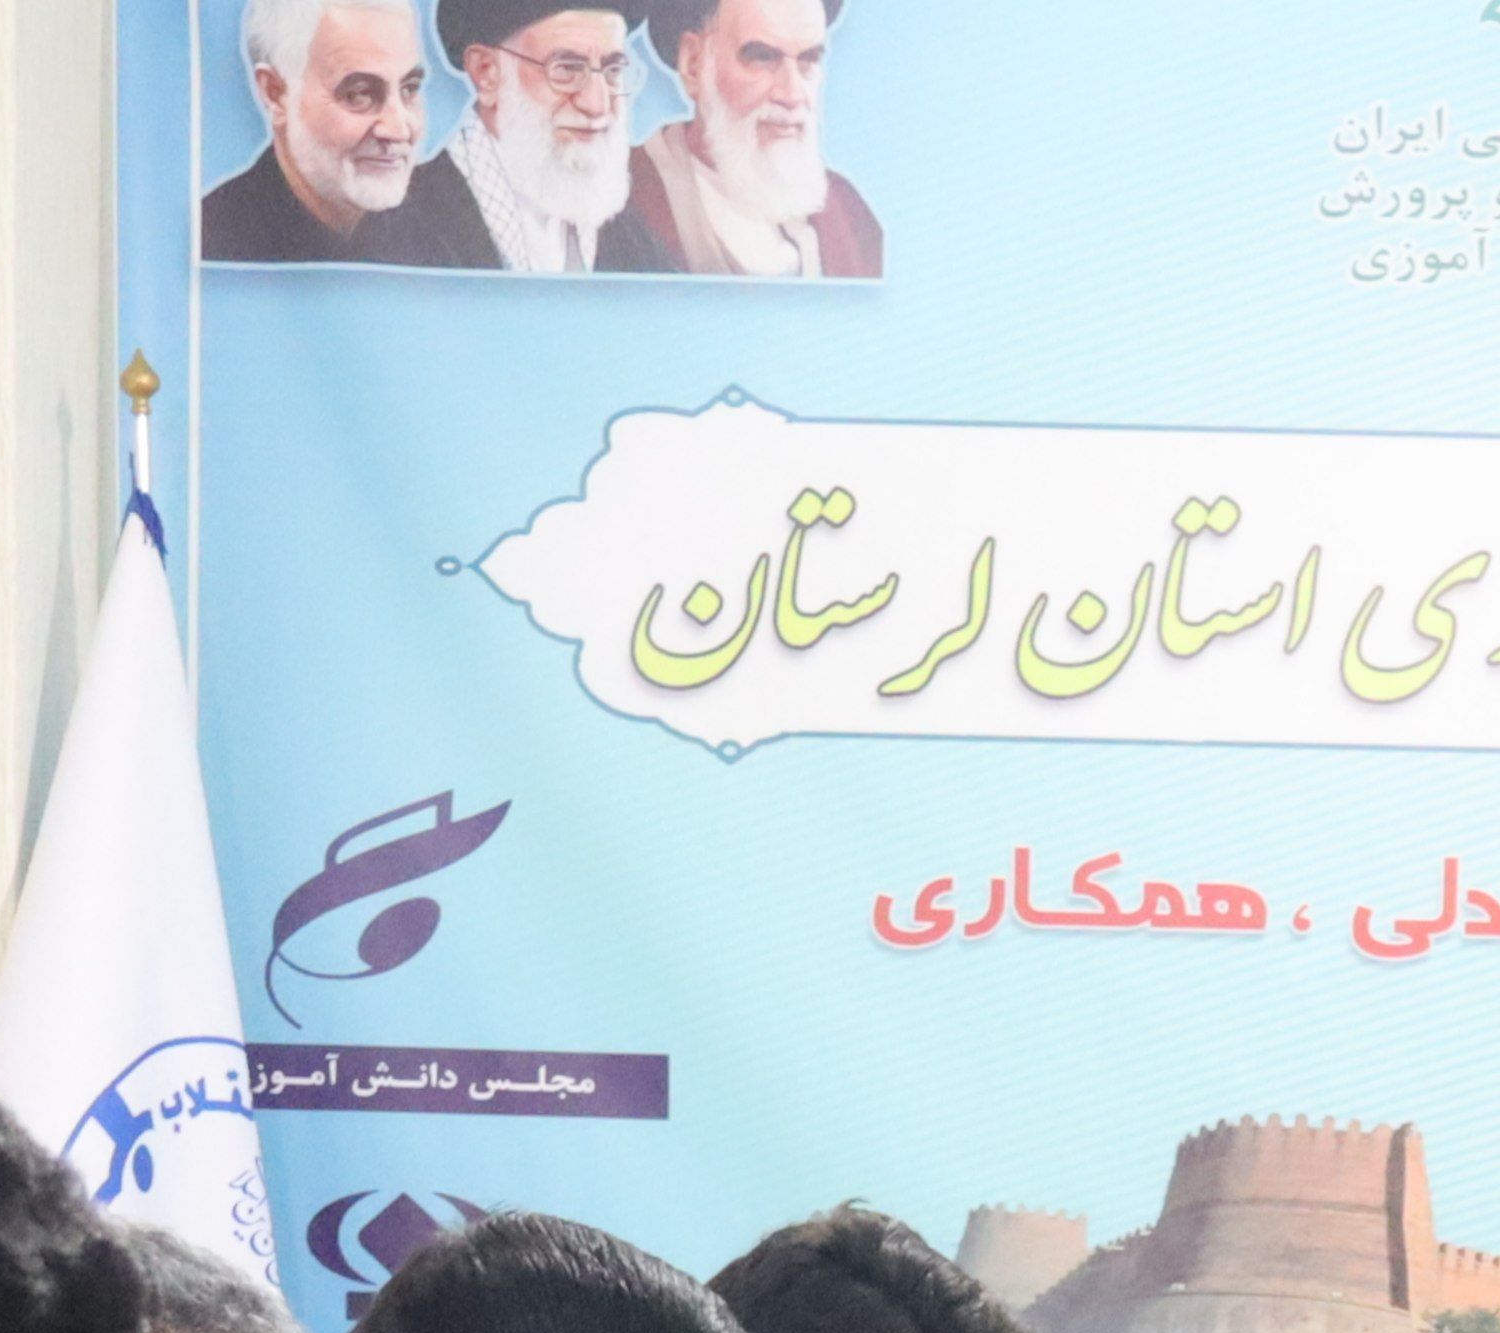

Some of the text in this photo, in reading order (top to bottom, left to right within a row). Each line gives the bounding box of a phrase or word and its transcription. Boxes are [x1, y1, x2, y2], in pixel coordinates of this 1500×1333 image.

[1332, 106, 1445, 156] ایران
[1318, 169, 1471, 222] پرورش
[1350, 227, 1492, 283] آموزی
[630, 486, 996, 699] لرستان
[1014, 495, 1323, 701] استان
[874, 846, 1268, 947] همکاری
[252, 1053, 597, 1101] مجلس دانش آموز
